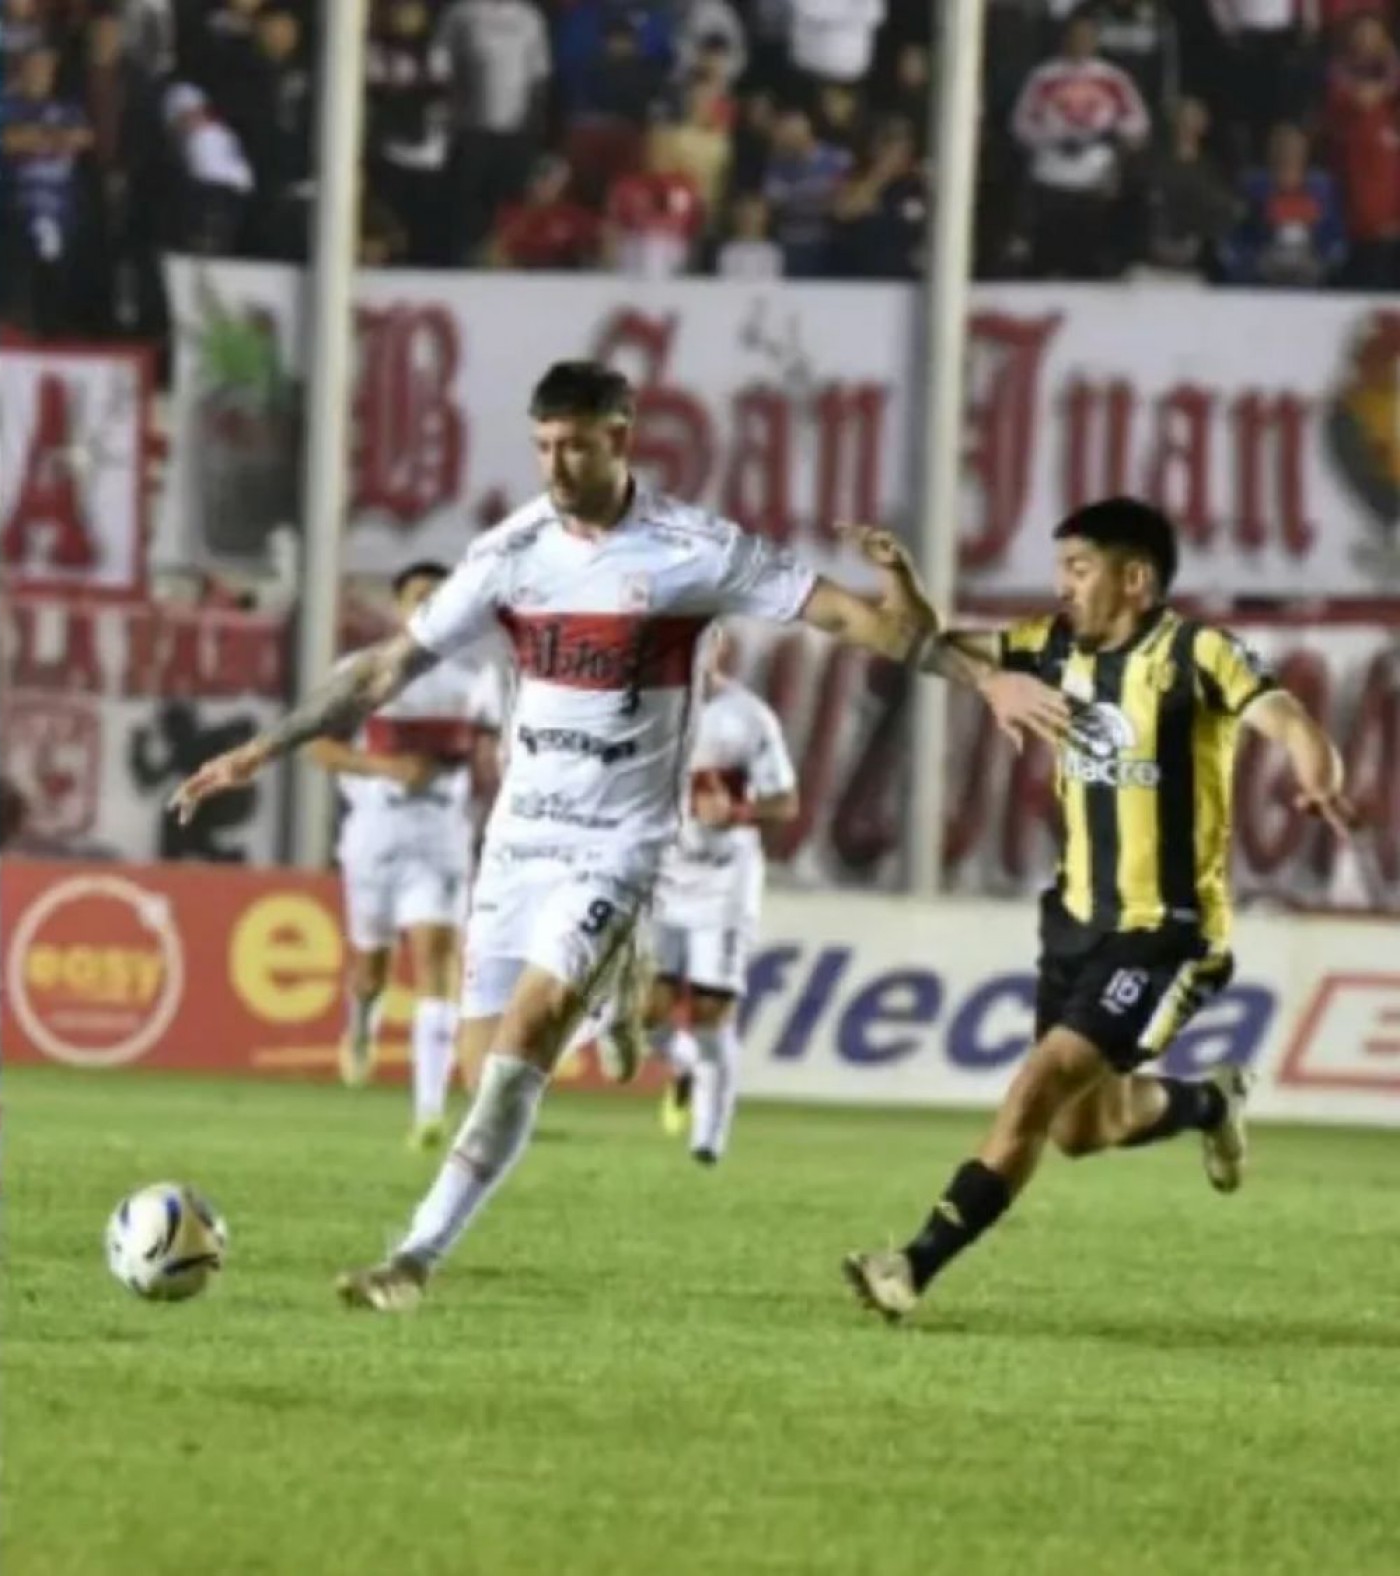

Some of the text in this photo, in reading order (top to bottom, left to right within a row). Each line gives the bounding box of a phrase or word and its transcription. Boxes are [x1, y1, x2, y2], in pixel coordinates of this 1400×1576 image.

[595, 304, 886, 545] San
[962, 306, 1314, 570] Juan
[579, 899, 615, 936] 9
